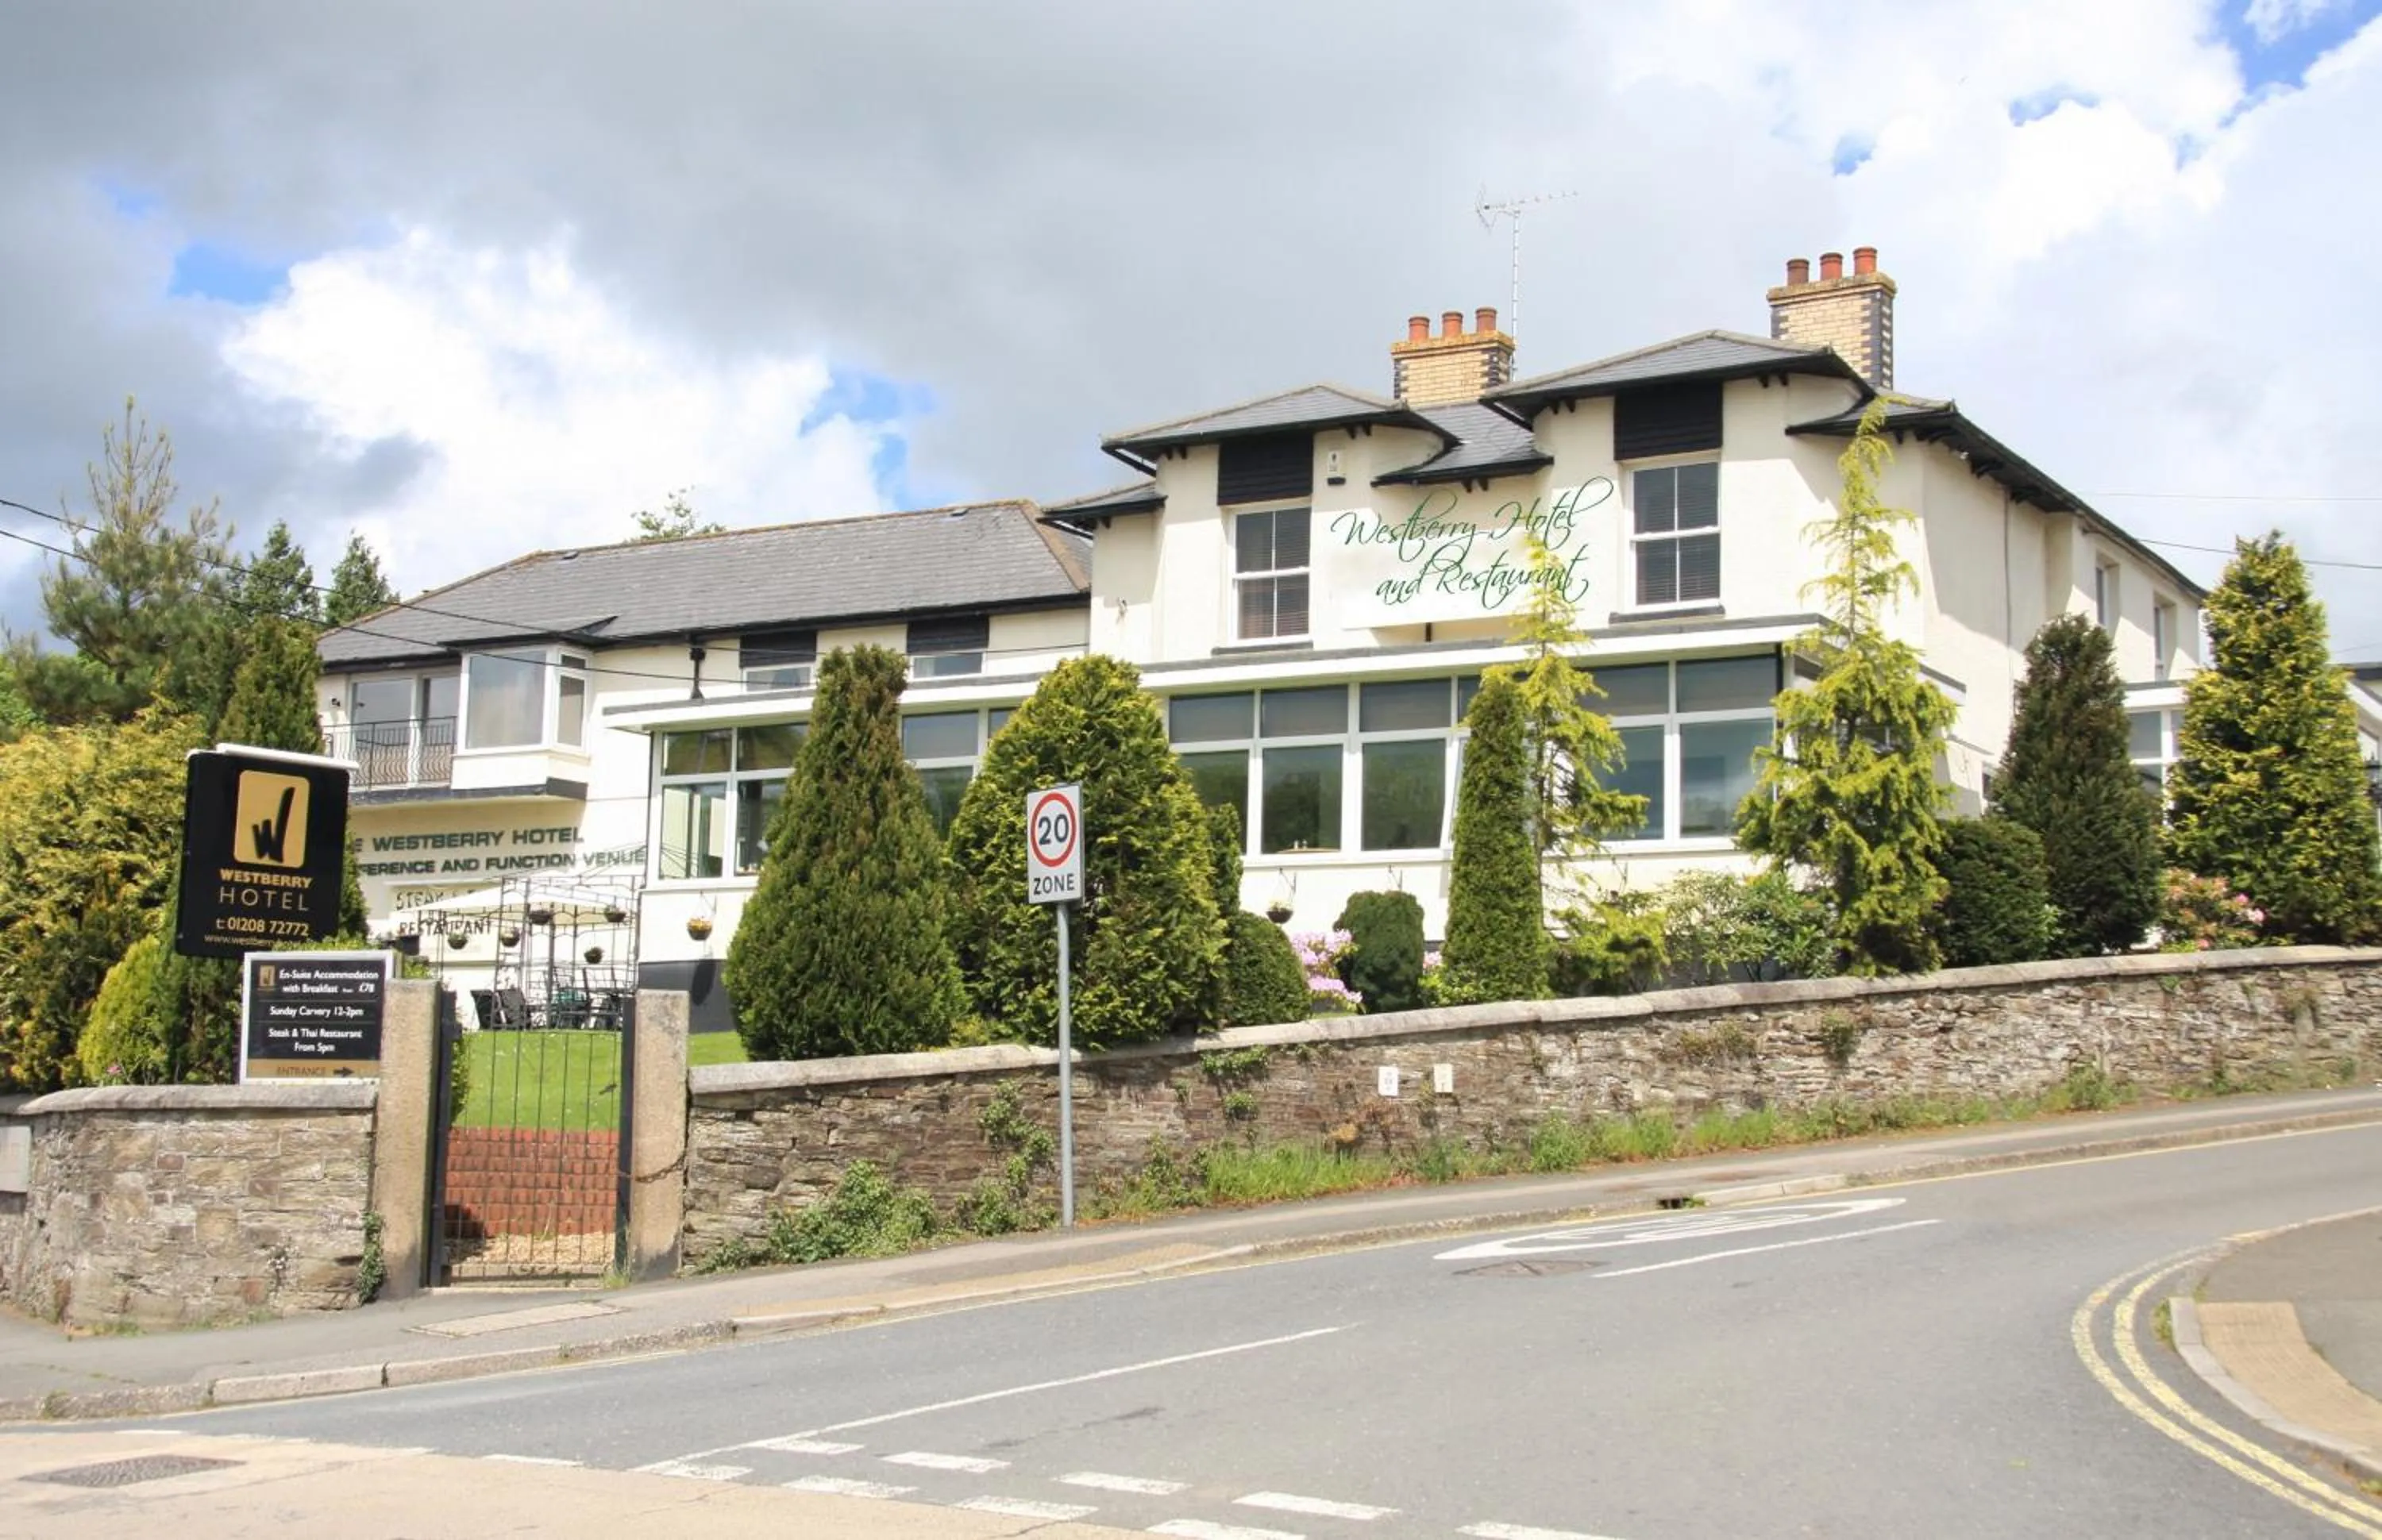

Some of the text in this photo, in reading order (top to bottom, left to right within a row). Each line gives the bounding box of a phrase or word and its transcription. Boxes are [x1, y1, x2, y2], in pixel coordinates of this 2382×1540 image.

[1331, 476, 1614, 564] Westberry Hotel
[1375, 544, 1589, 610] and Restaurant
[373, 830, 505, 852] WESTBERRY
[512, 826, 584, 845] HOTEL
[1039, 814, 1069, 845] 20
[441, 858, 480, 872] AND
[486, 853, 576, 871] FUNCTION
[583, 849, 647, 866] VENUE
[220, 868, 314, 888] WESTBERRY
[1033, 873, 1075, 895] ZONE
[220, 886, 309, 911] HOTEL
[227, 916, 265, 933] 01208
[269, 920, 310, 936] 72772
[314, 969, 379, 979] Accommodation
[282, 984, 300, 993] with
[302, 984, 338, 993] Breakfast
[269, 1006, 364, 1018] Sunday Carvery 12-2pm
[268, 1027, 290, 1038] Steak
[300, 1027, 318, 1038] Thai
[319, 1028, 363, 1038] Restaurant
[294, 1042, 315, 1052] From
